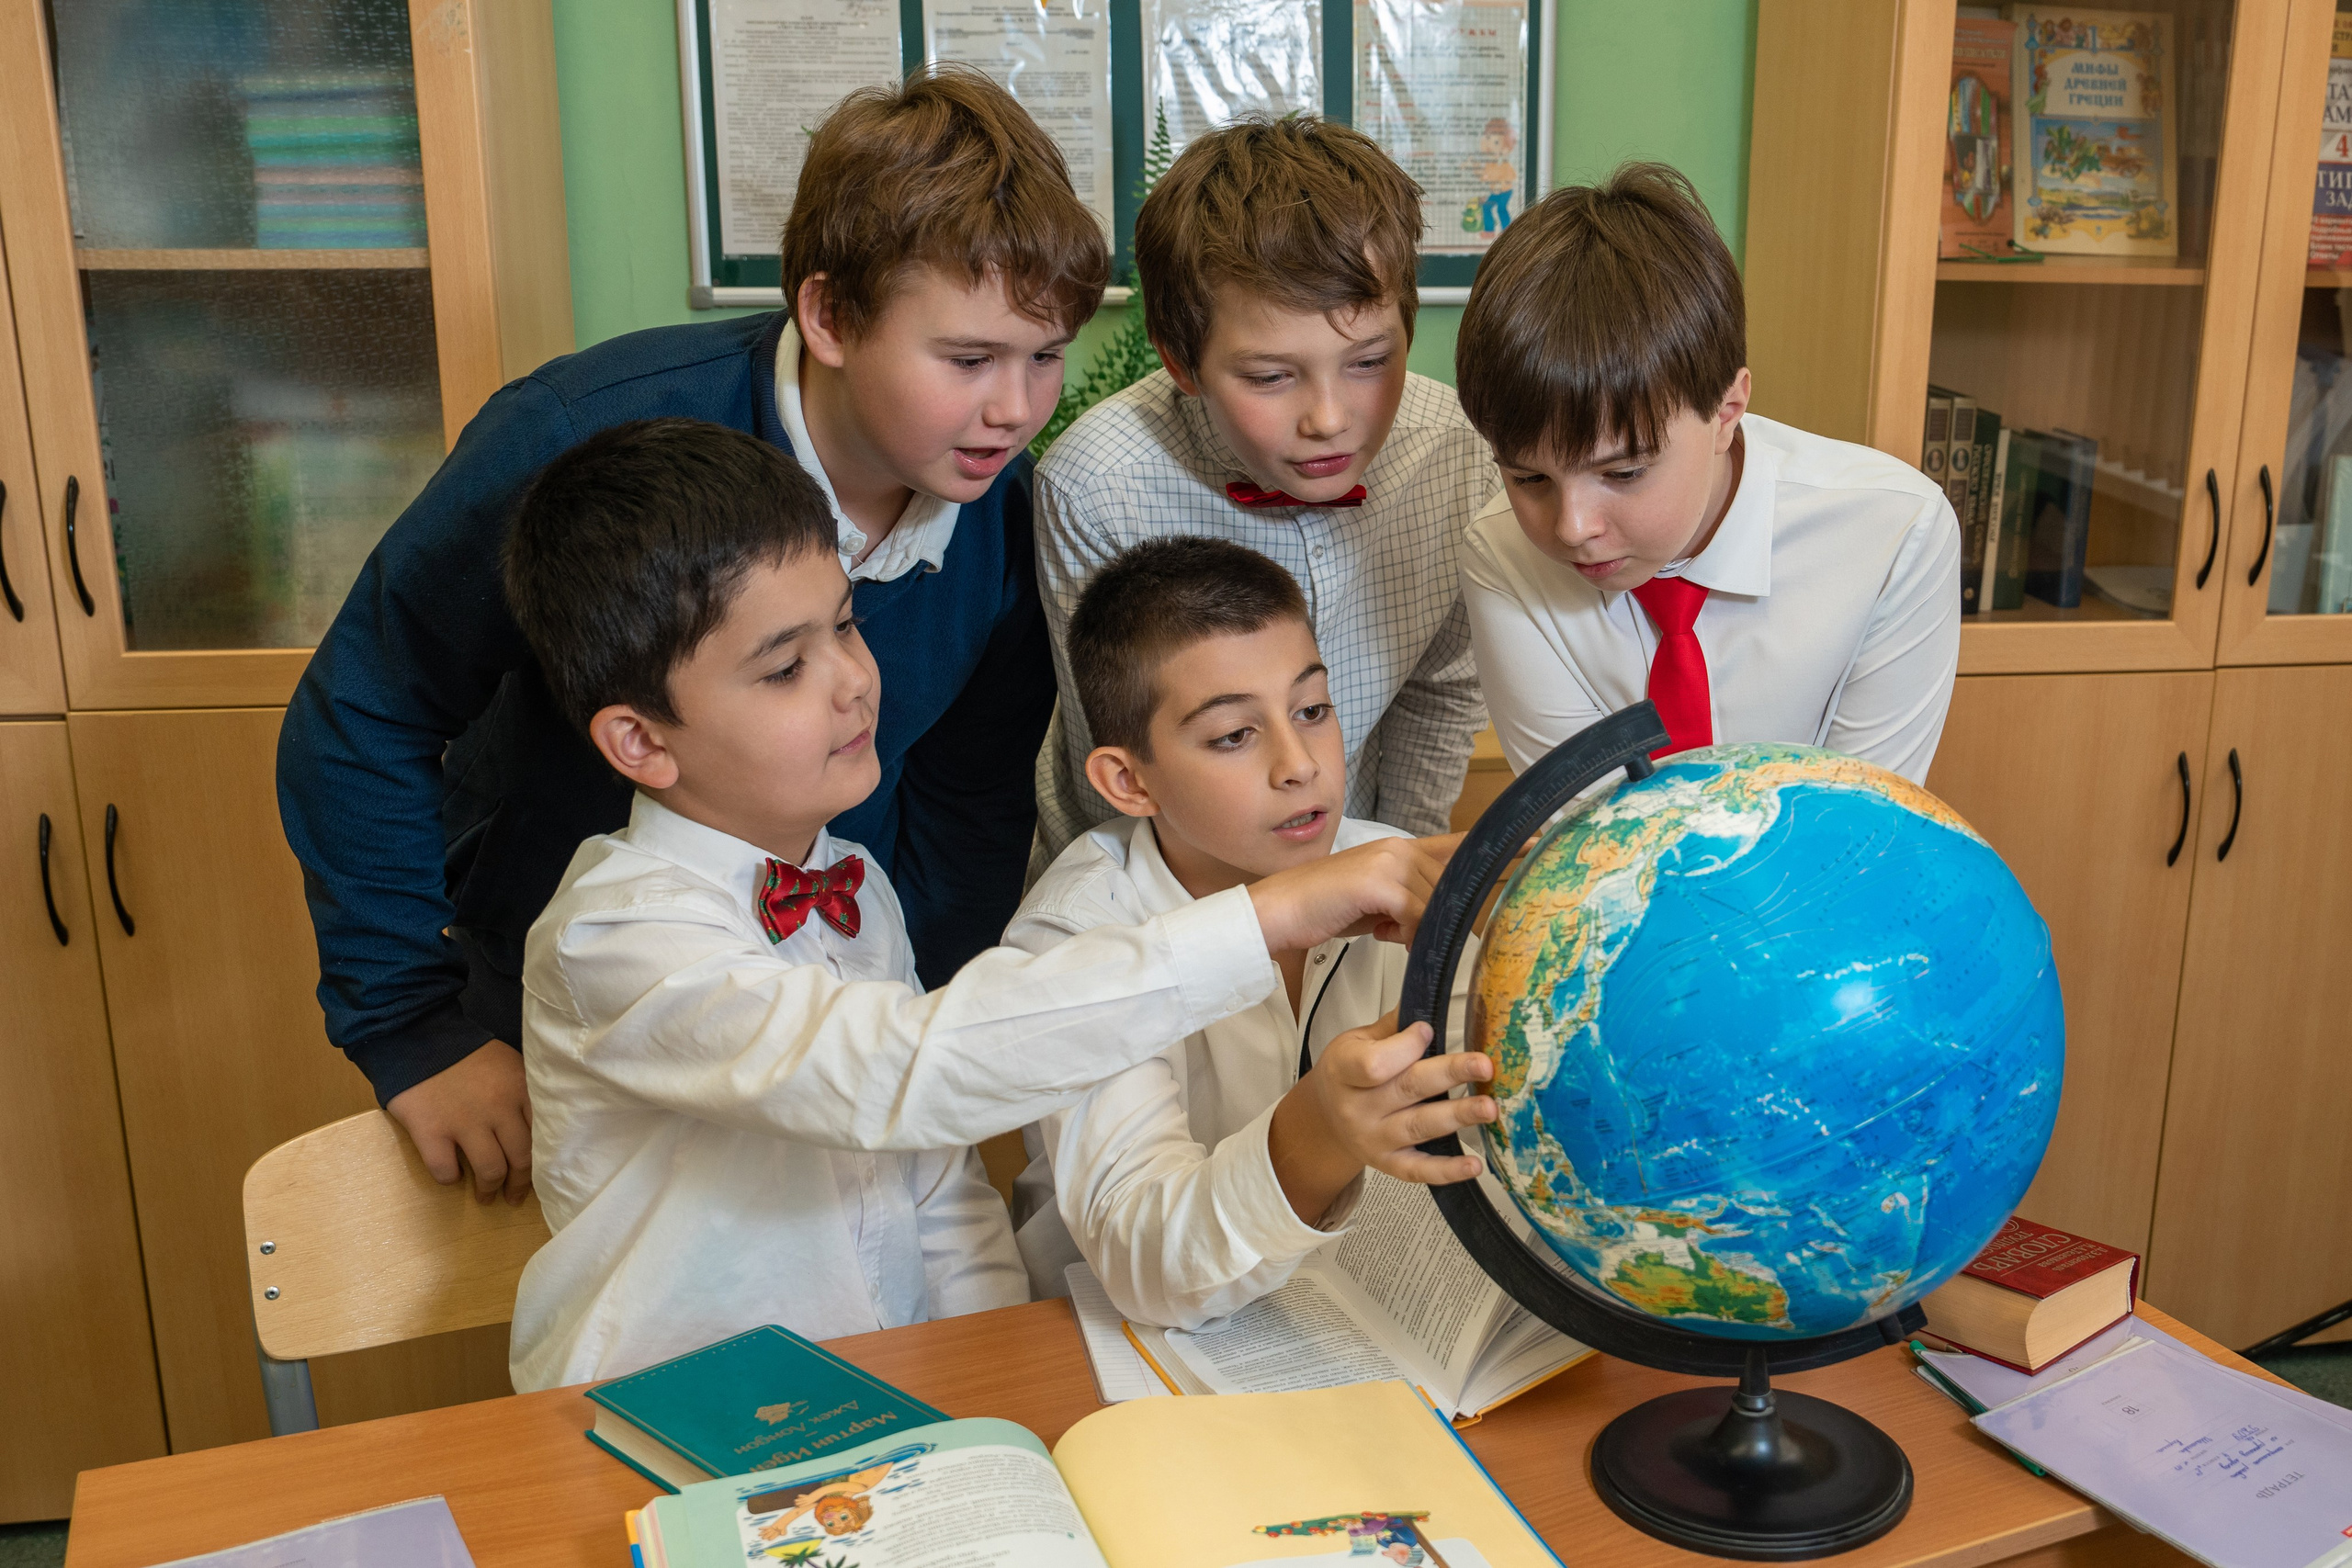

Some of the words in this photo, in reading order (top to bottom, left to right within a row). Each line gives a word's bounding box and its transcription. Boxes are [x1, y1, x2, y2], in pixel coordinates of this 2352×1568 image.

[2072, 62, 2119, 75] МИФЫ
[2064, 77, 2127, 91] ДРЕВНЕЙ
[2069, 93, 2123, 107] ГРЕЦИИ
[2335, 134, 2349, 157] 4
[1973, 1233, 2071, 1271] СЛОВАРЬ
[808, 1400, 859, 1424] Джек
[2121, 1404, 2140, 1415] 18
[734, 1422, 806, 1454] Лондон
[811, 1411, 899, 1450] Мартин
[749, 1446, 813, 1473] Иден
[2256, 1471, 2306, 1499] ТЕТРАДЬ
